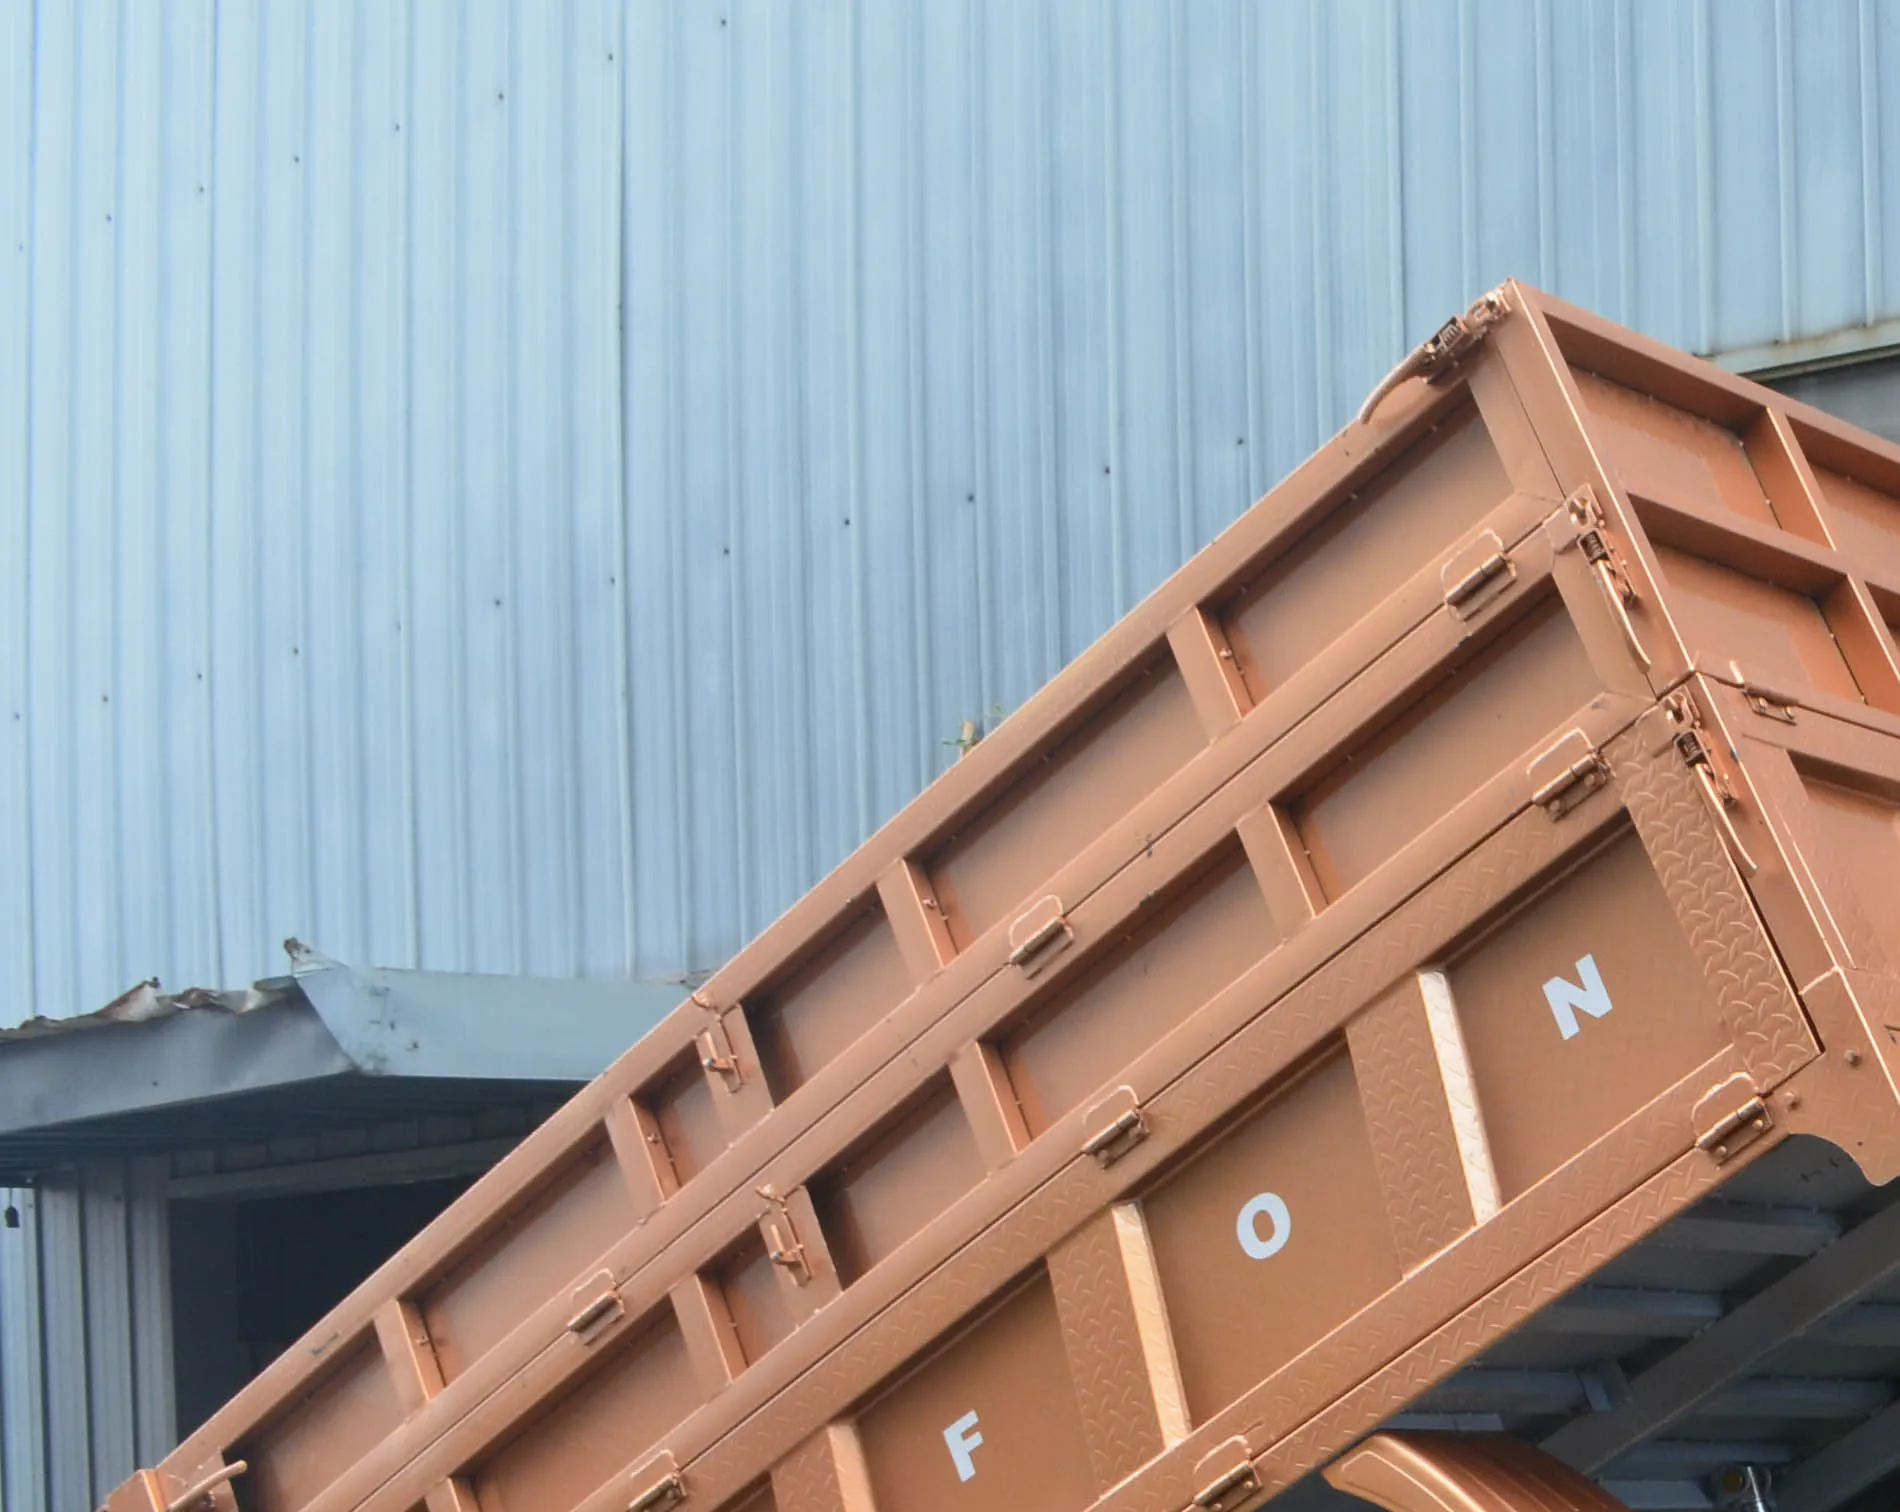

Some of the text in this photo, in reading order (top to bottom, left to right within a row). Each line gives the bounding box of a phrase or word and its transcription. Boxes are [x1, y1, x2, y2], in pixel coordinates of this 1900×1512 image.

[942, 1410, 985, 1482] F
[1236, 1191, 1293, 1261] O
[1542, 952, 1614, 1041] N
